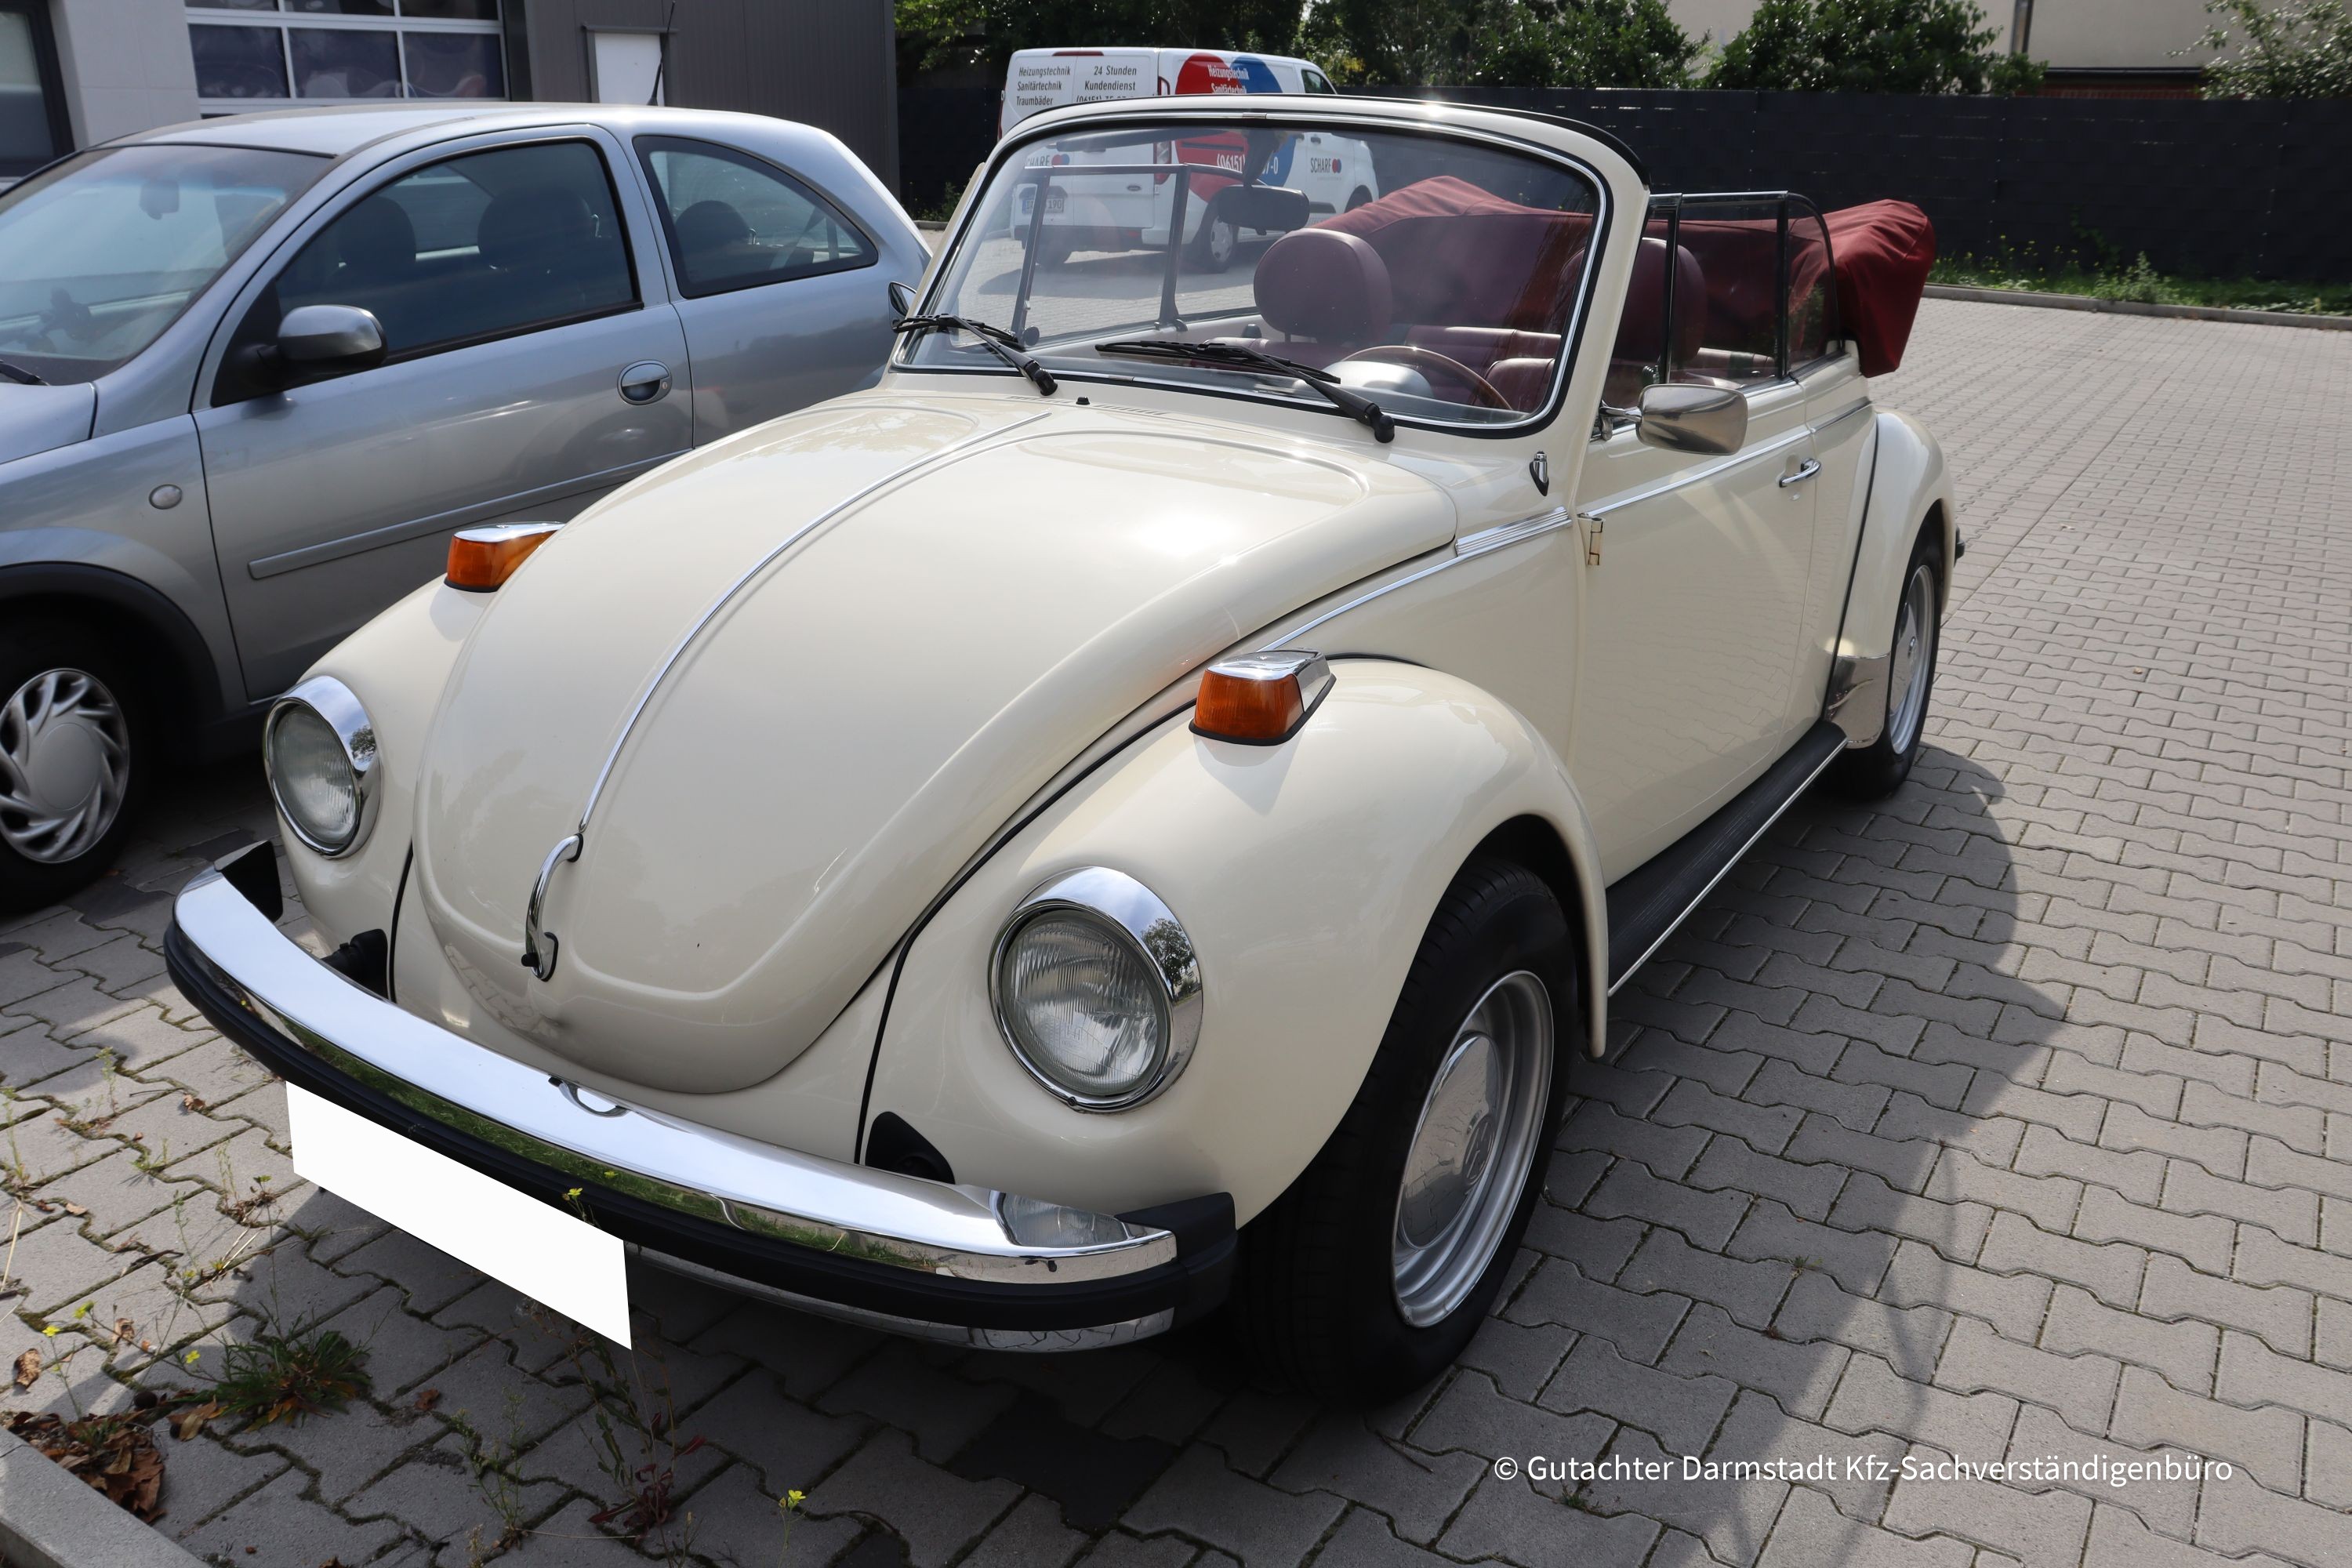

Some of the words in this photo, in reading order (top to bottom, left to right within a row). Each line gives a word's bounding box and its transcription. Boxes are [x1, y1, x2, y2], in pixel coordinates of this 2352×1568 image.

[1018, 66, 1071, 78] Heizungstechnik
[1094, 66, 1103, 75] 24
[1105, 65, 1137, 75] Stunden
[1017, 81, 1062, 91] Sanitärtechnik
[1084, 81, 1135, 90] Kundendienst
[1016, 96, 1053, 106] Traumbäder
[1310, 158, 1331, 173] SCHARF
